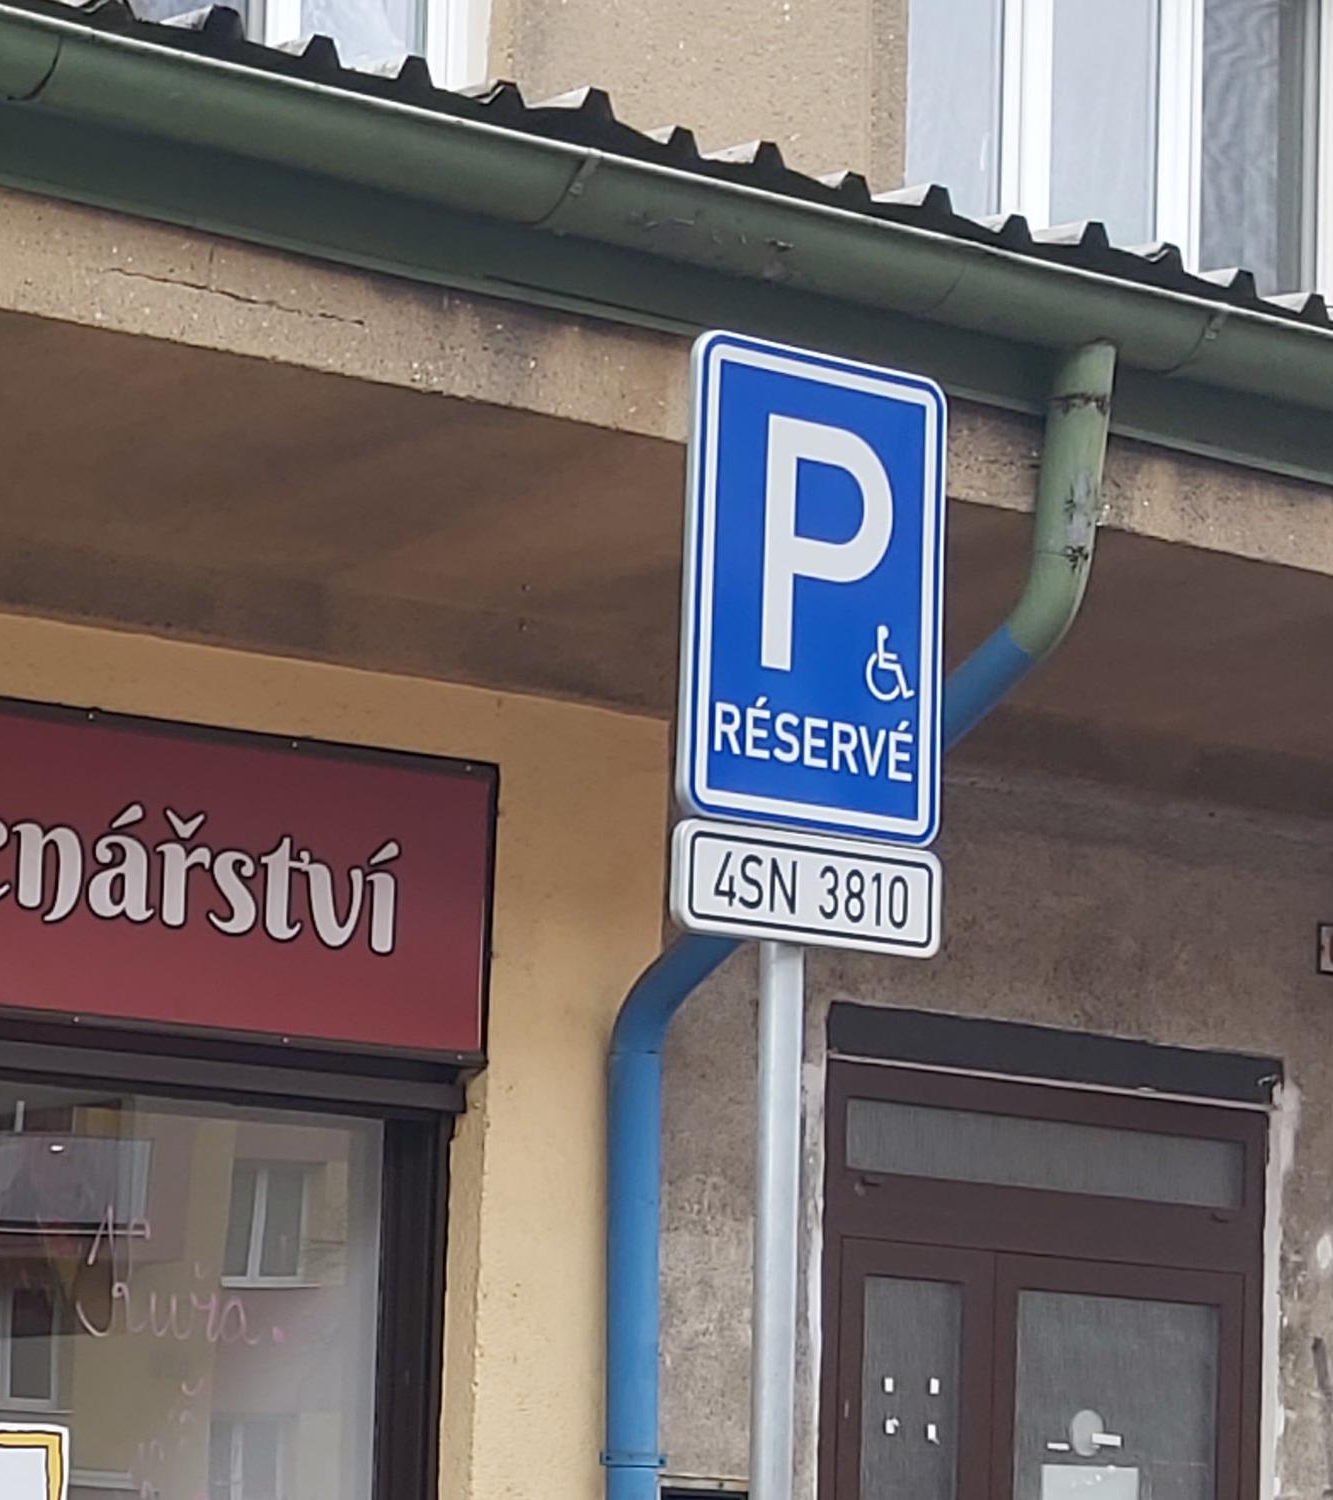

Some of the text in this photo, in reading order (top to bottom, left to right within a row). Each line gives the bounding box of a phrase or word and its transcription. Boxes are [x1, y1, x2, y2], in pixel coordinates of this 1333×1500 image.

[760, 412, 894, 672] P
[713, 696, 915, 784] RÉSERVÉ
[714, 849, 910, 930] 4SN 3810
